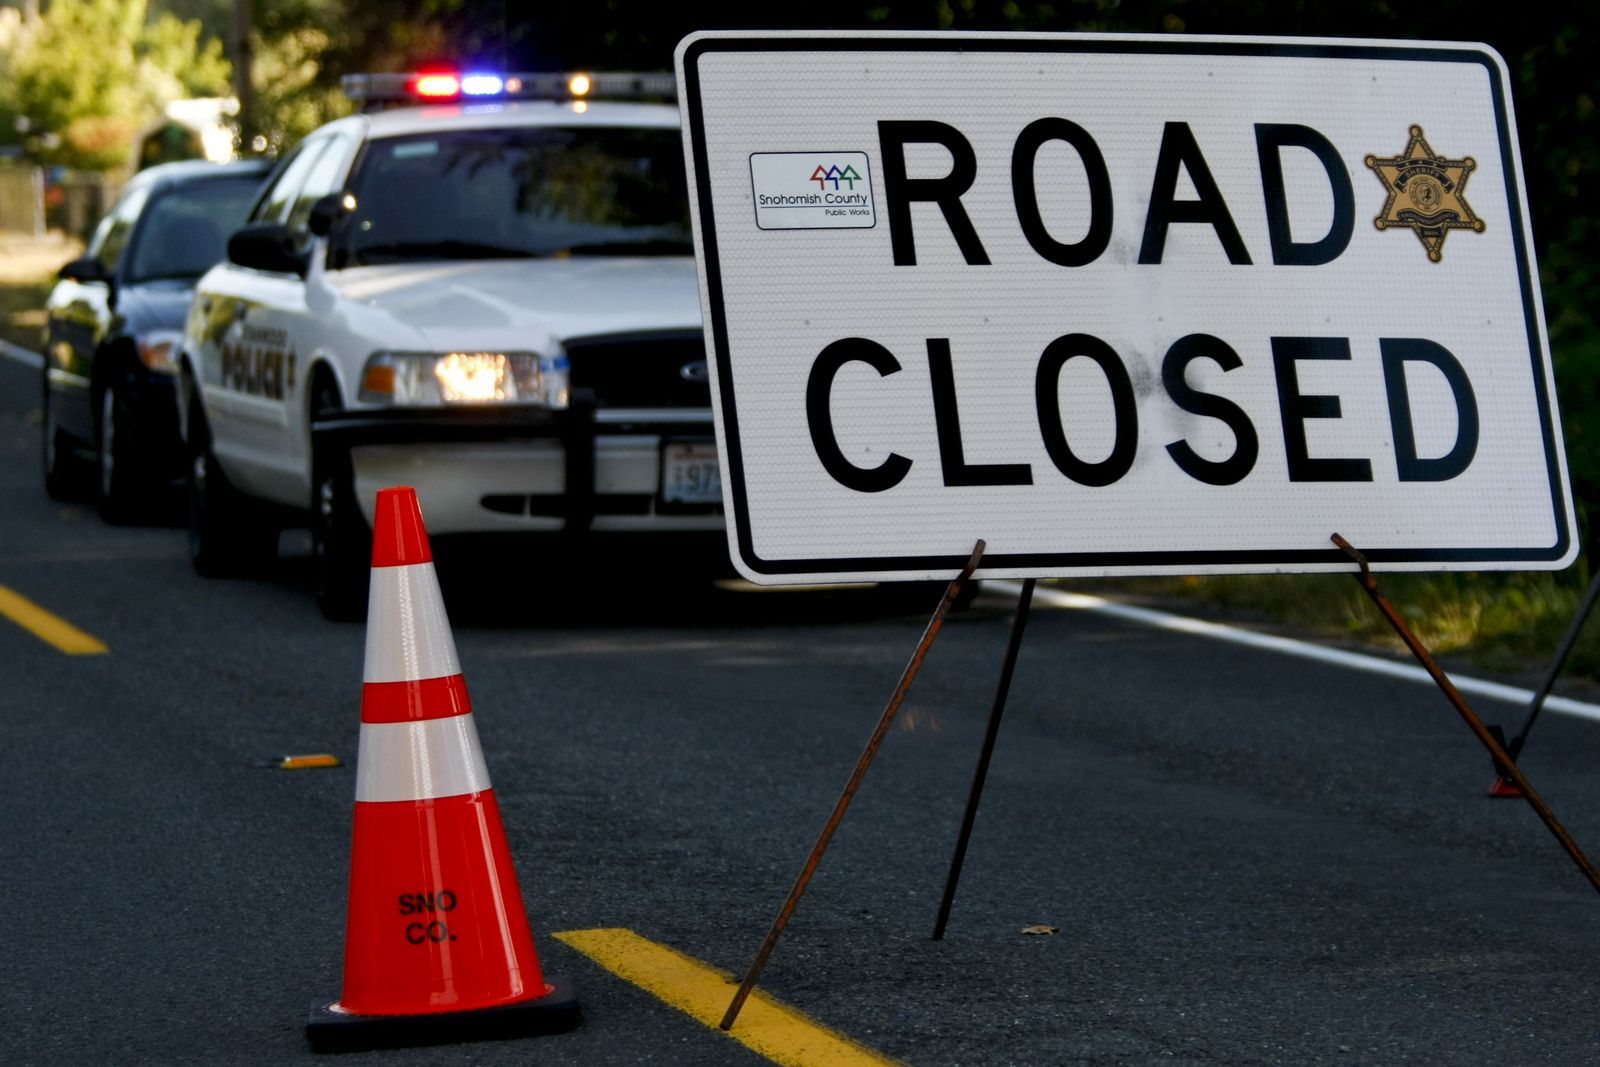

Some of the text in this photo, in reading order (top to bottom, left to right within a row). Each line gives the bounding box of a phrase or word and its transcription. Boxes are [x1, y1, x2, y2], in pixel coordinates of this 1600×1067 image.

[1405, 167, 1440, 179] SHERIFF
[759, 193, 868, 205] Snohomish County
[877, 117, 1355, 267] ROAD
[849, 208, 870, 216] Works
[806, 333, 1479, 493] CLOSED
[399, 890, 456, 915] SNO
[406, 921, 457, 944] CO.
